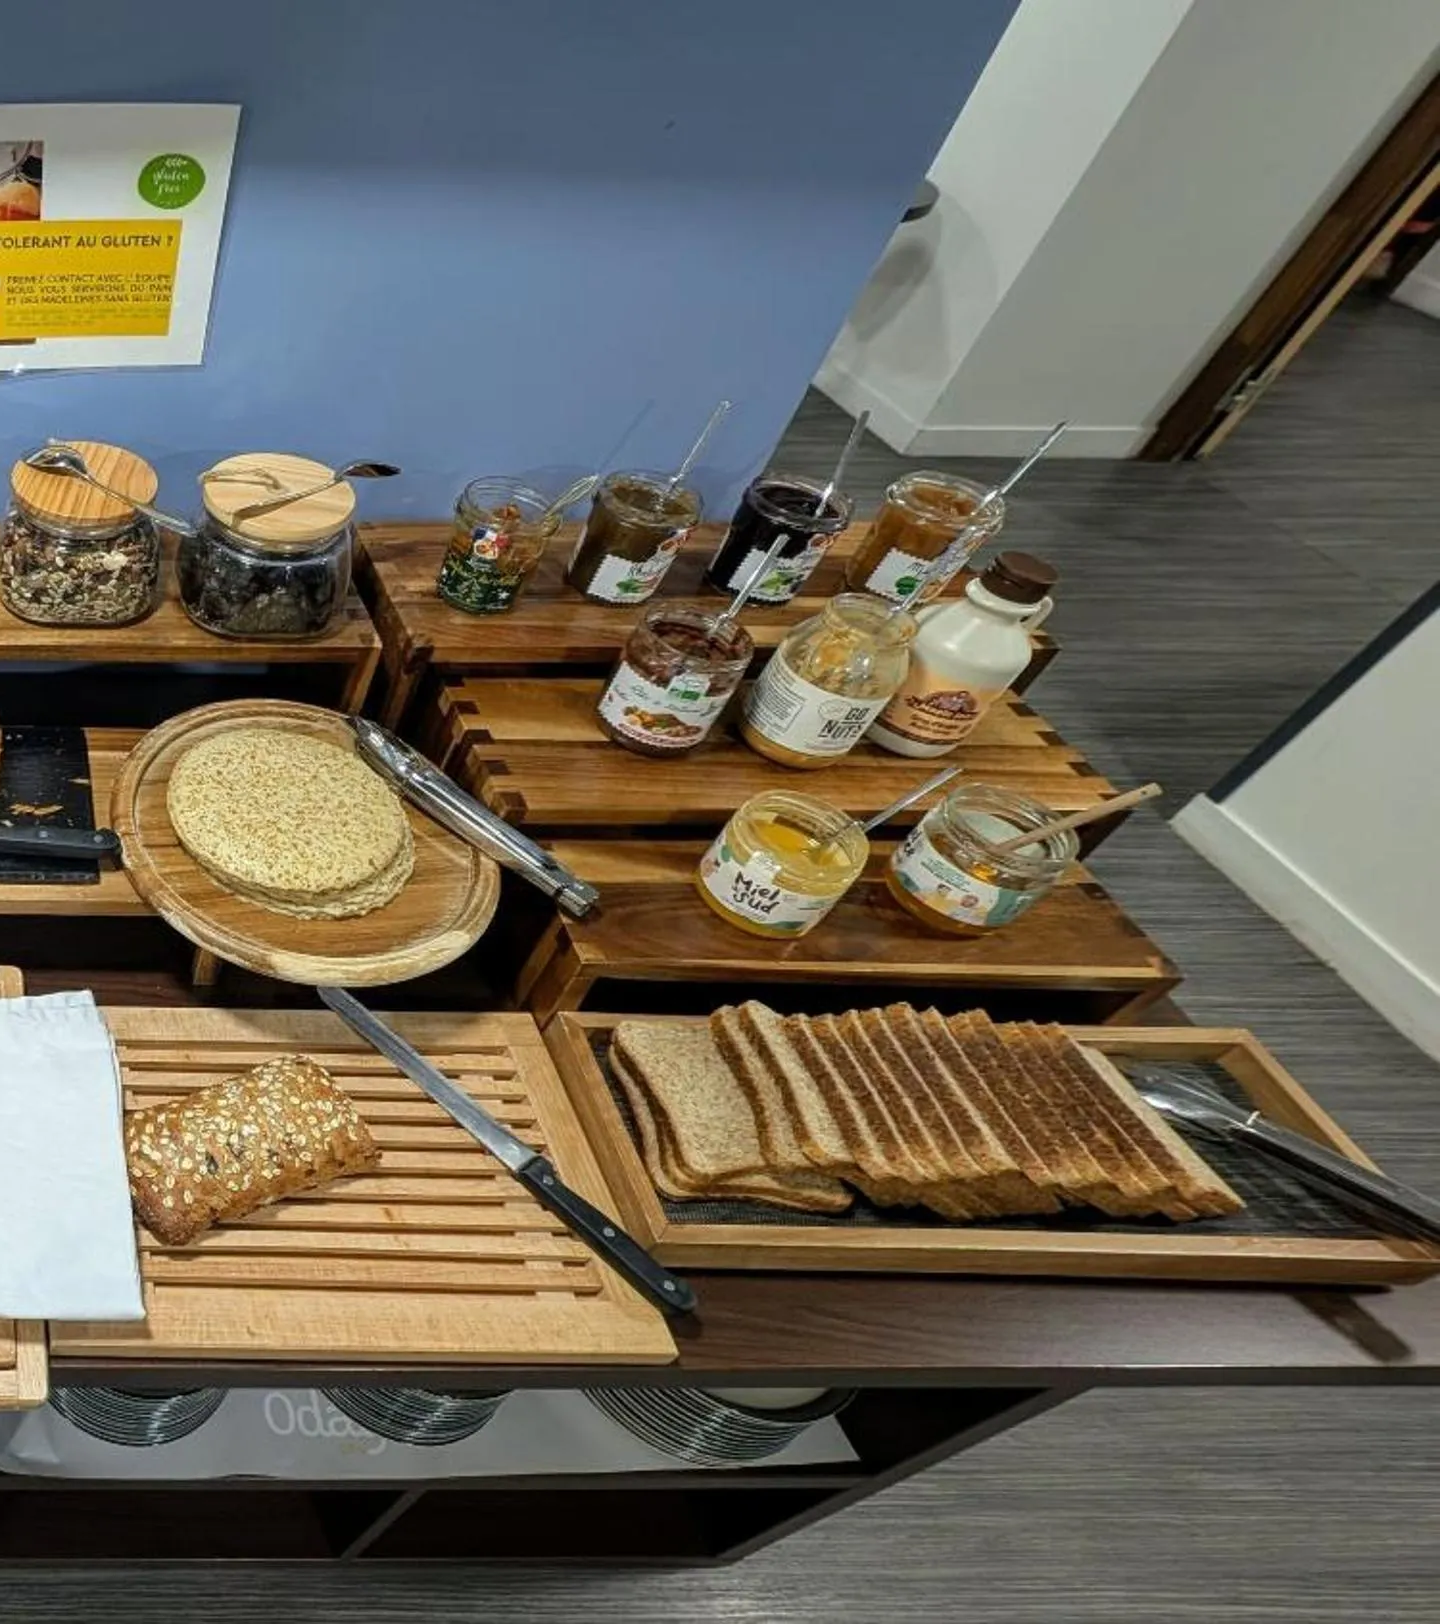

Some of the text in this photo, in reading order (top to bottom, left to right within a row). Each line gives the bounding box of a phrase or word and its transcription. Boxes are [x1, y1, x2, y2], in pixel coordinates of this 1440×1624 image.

[76, 235, 97, 249] AU
[101, 234, 162, 249] GLUTEN
[166, 235, 174, 247] ?
[47, 273, 95, 284] CONTACT
[97, 273, 123, 284] AVEC
[6, 285, 35, 295] NOUS
[40, 285, 67, 294] VOUS
[844, 707, 871, 721] GO
[818, 719, 864, 739] NUTS
[734, 871, 781, 901] Miel
